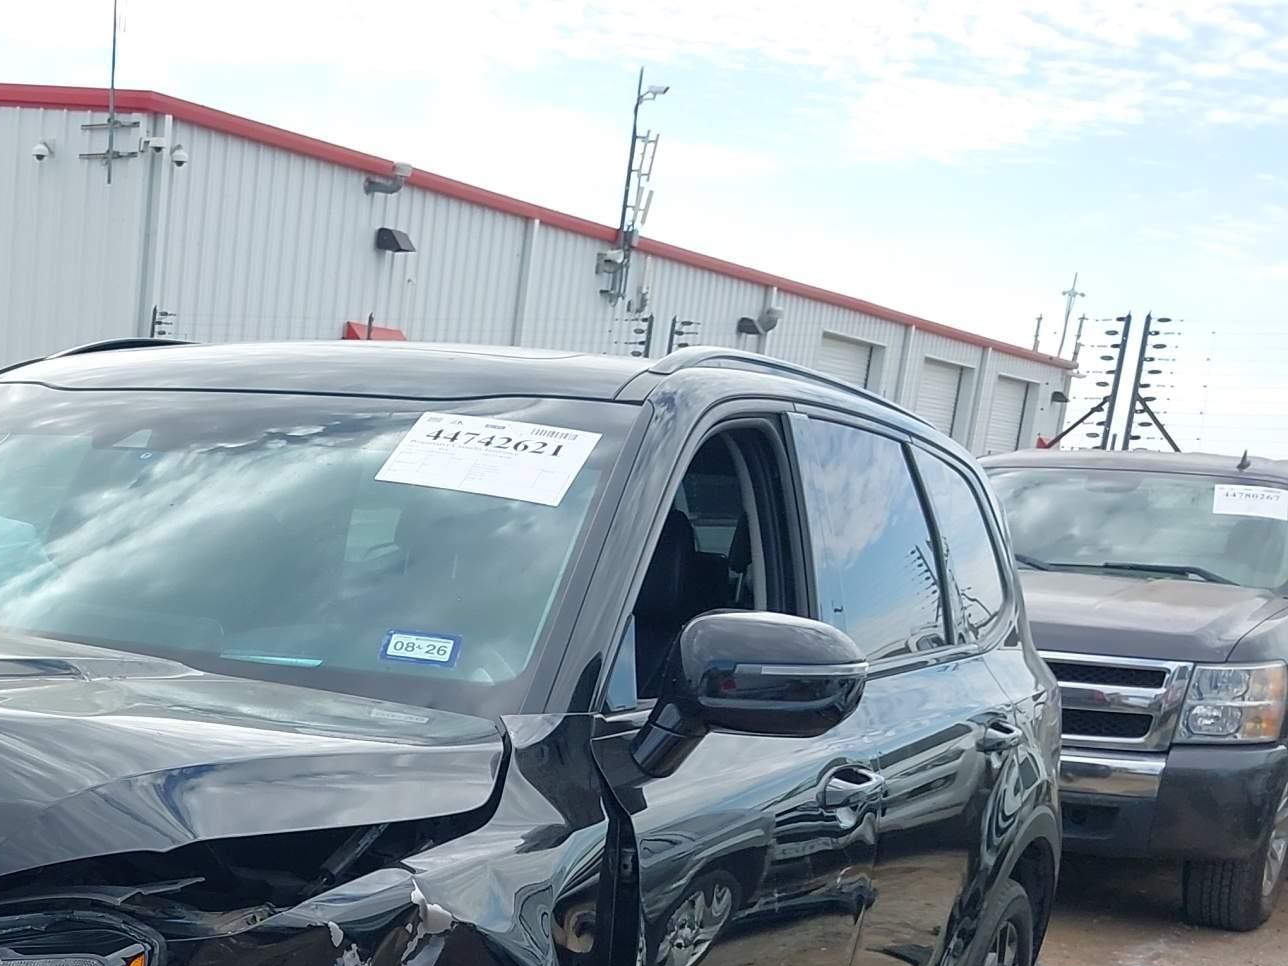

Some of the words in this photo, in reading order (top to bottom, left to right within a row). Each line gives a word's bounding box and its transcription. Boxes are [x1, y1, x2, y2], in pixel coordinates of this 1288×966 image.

[426, 428, 563, 457] 44742621
[393, 640, 415, 653] 08
[425, 644, 448, 656] 26
